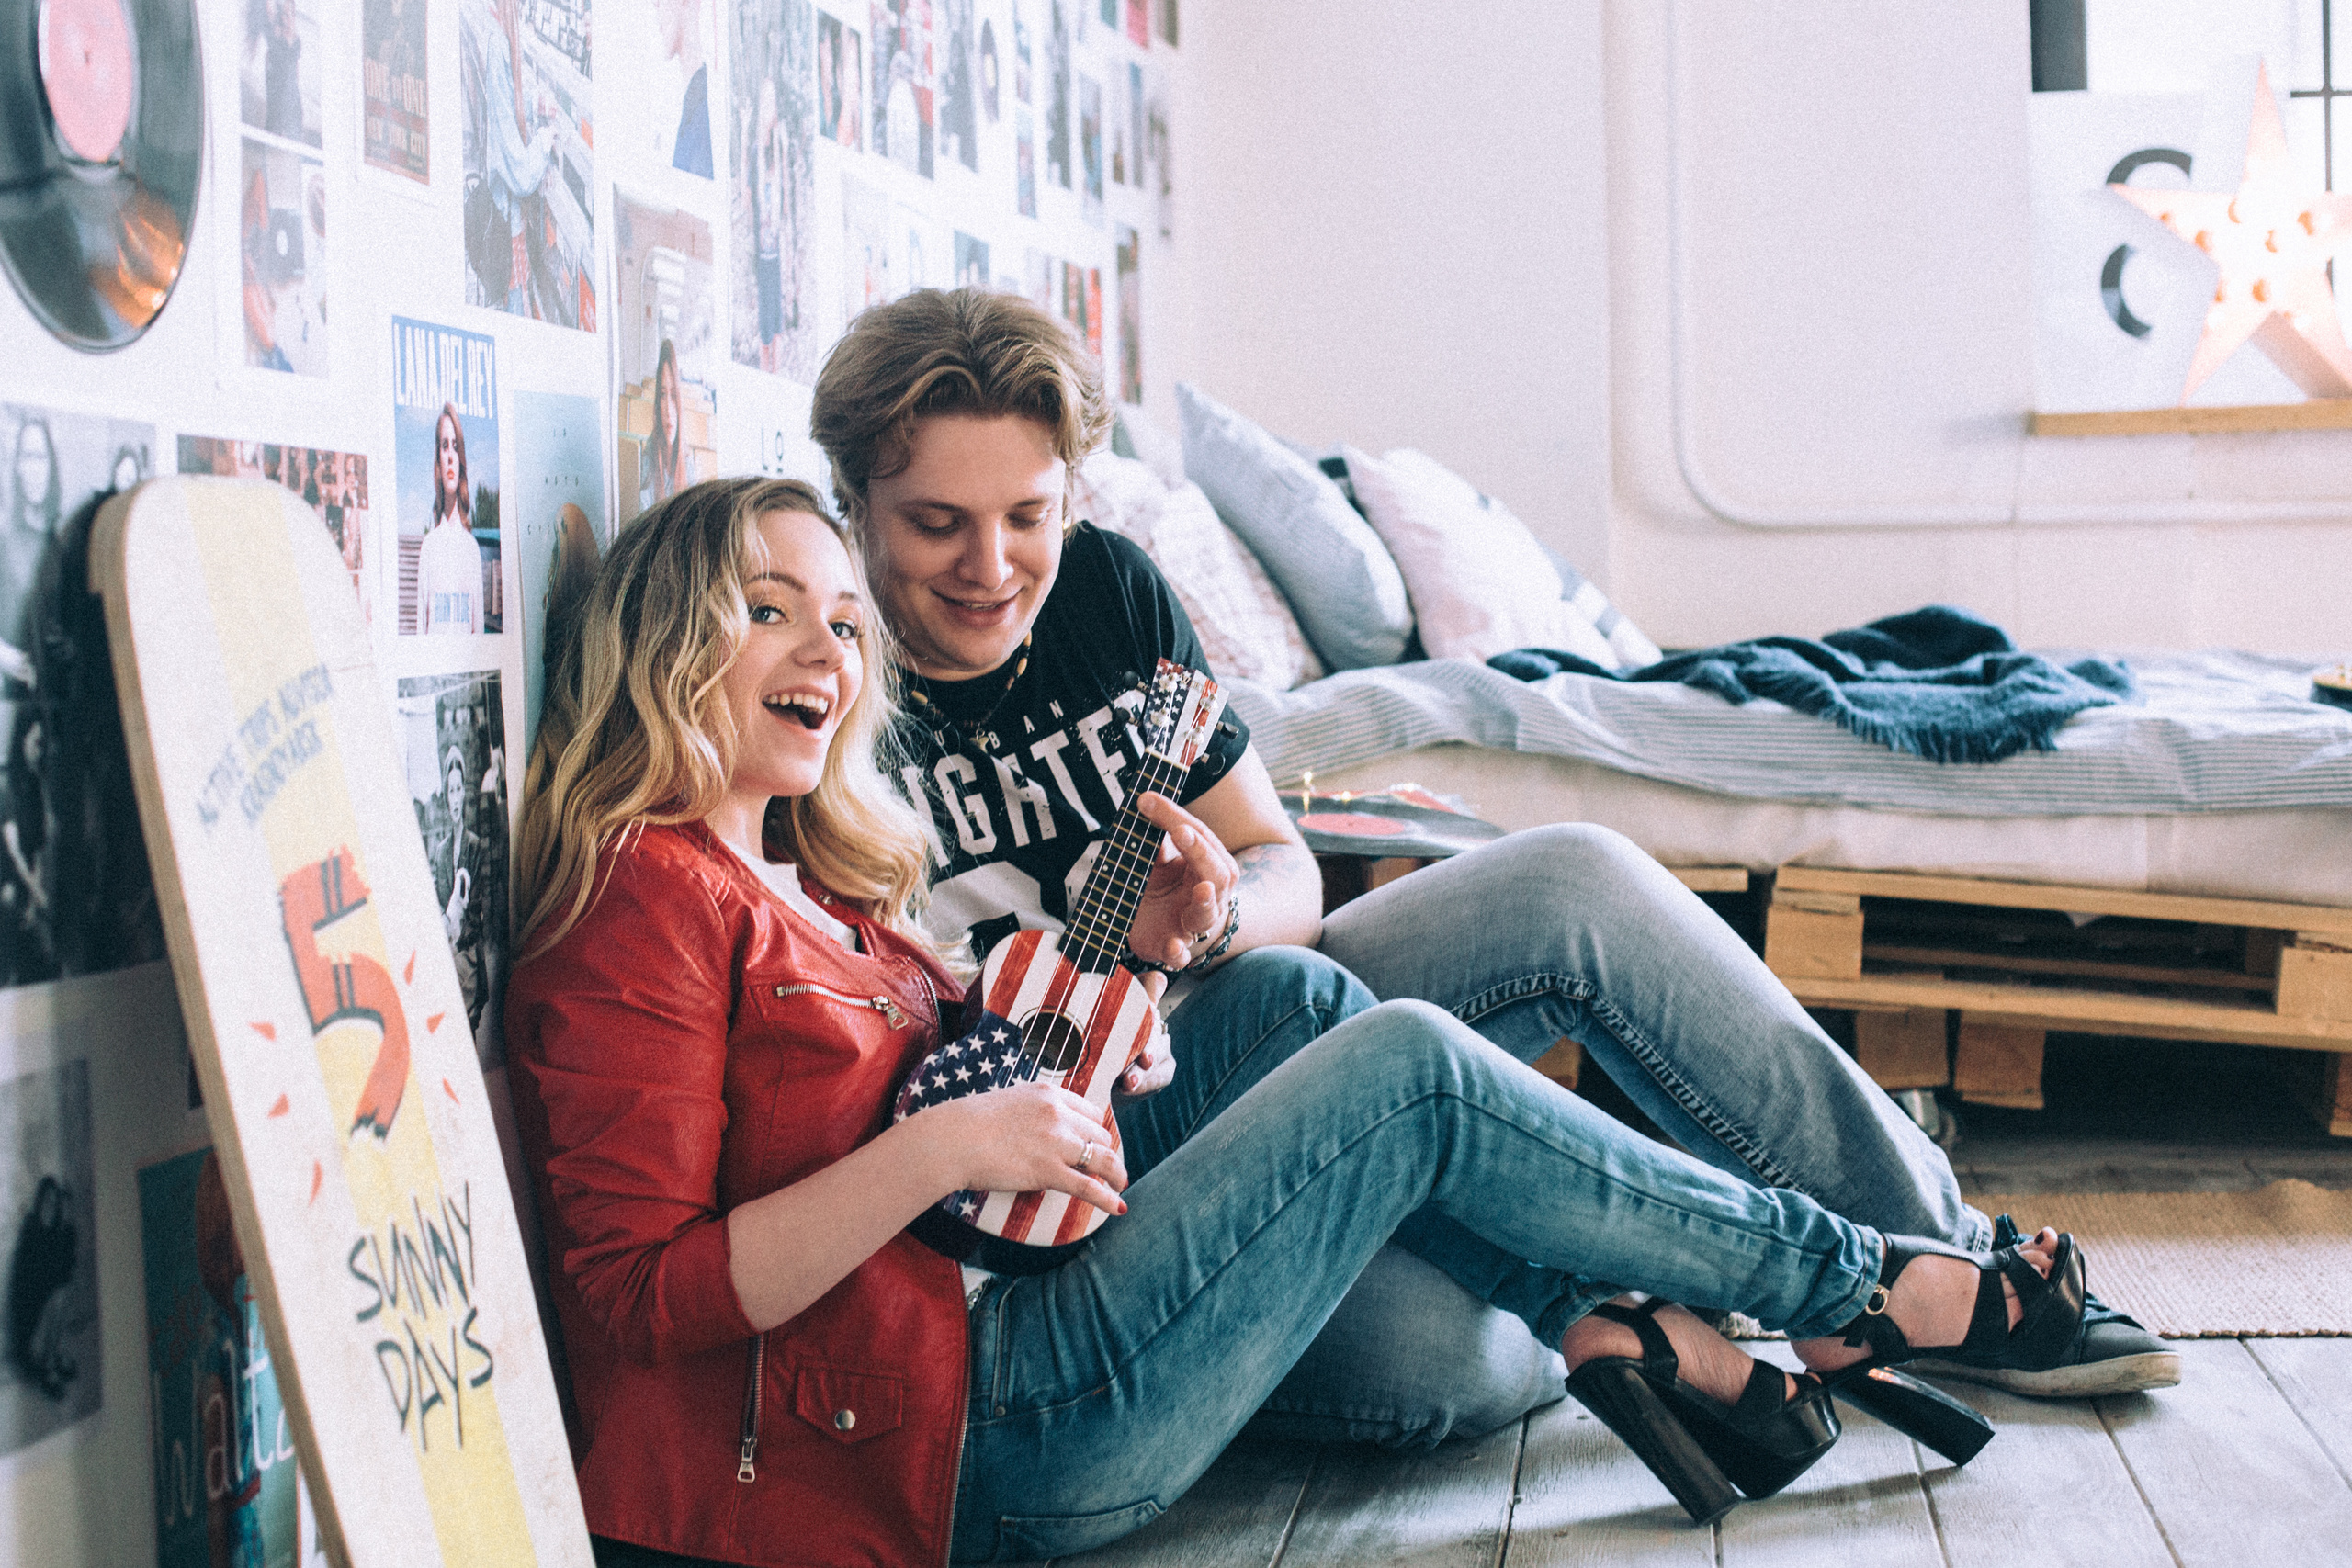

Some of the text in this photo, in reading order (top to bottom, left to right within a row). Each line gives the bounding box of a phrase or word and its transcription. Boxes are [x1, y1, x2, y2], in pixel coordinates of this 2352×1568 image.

[393, 322, 493, 419] LANA DEL REY
[278, 842, 411, 1145] 5
[347, 1179, 476, 1324] SUNNY
[374, 1306, 494, 1454] DAYS
